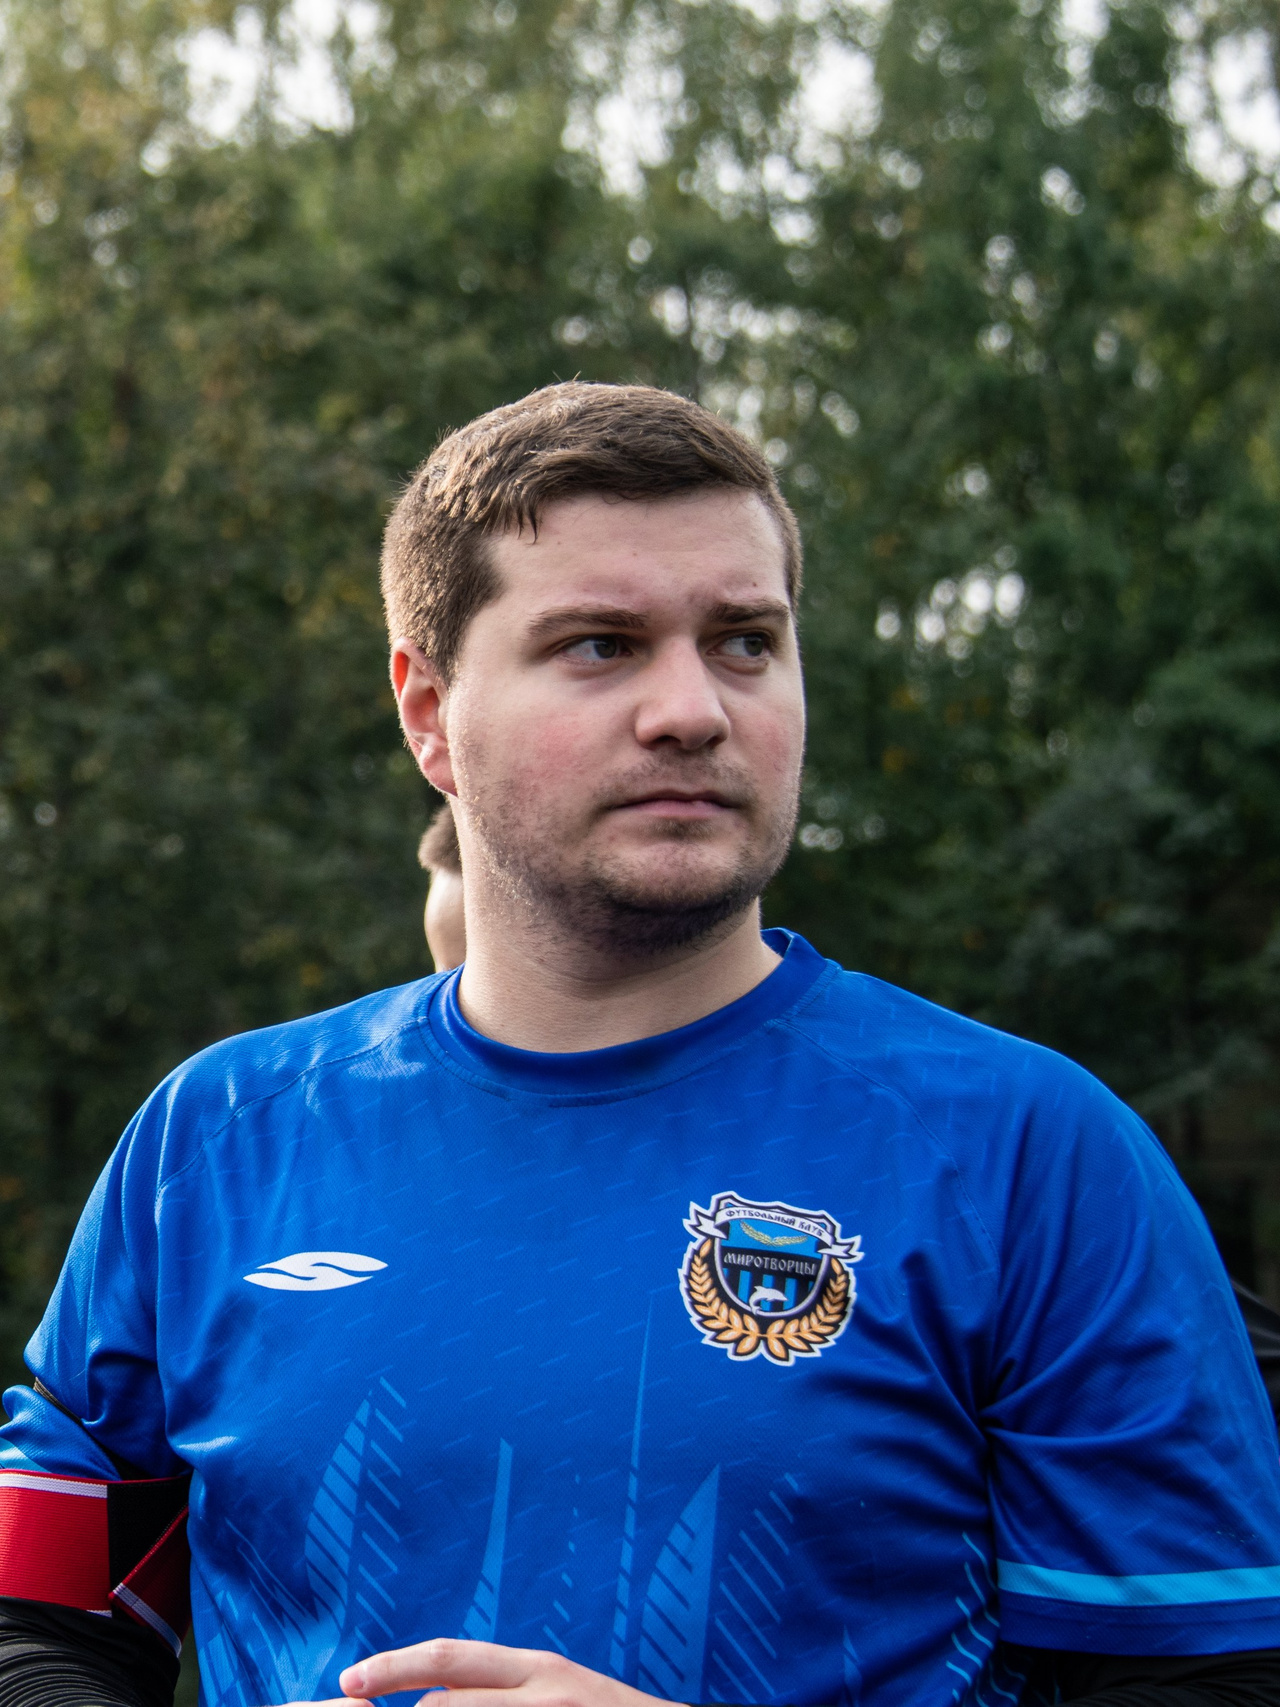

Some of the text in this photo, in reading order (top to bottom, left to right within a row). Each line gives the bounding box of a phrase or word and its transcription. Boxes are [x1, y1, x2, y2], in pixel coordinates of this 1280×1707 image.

[725, 1209, 825, 1237] ФУТБОЛЬНЫЙ КЛУБ
[723, 1252, 816, 1276] МИРОТВОРЦЫ
